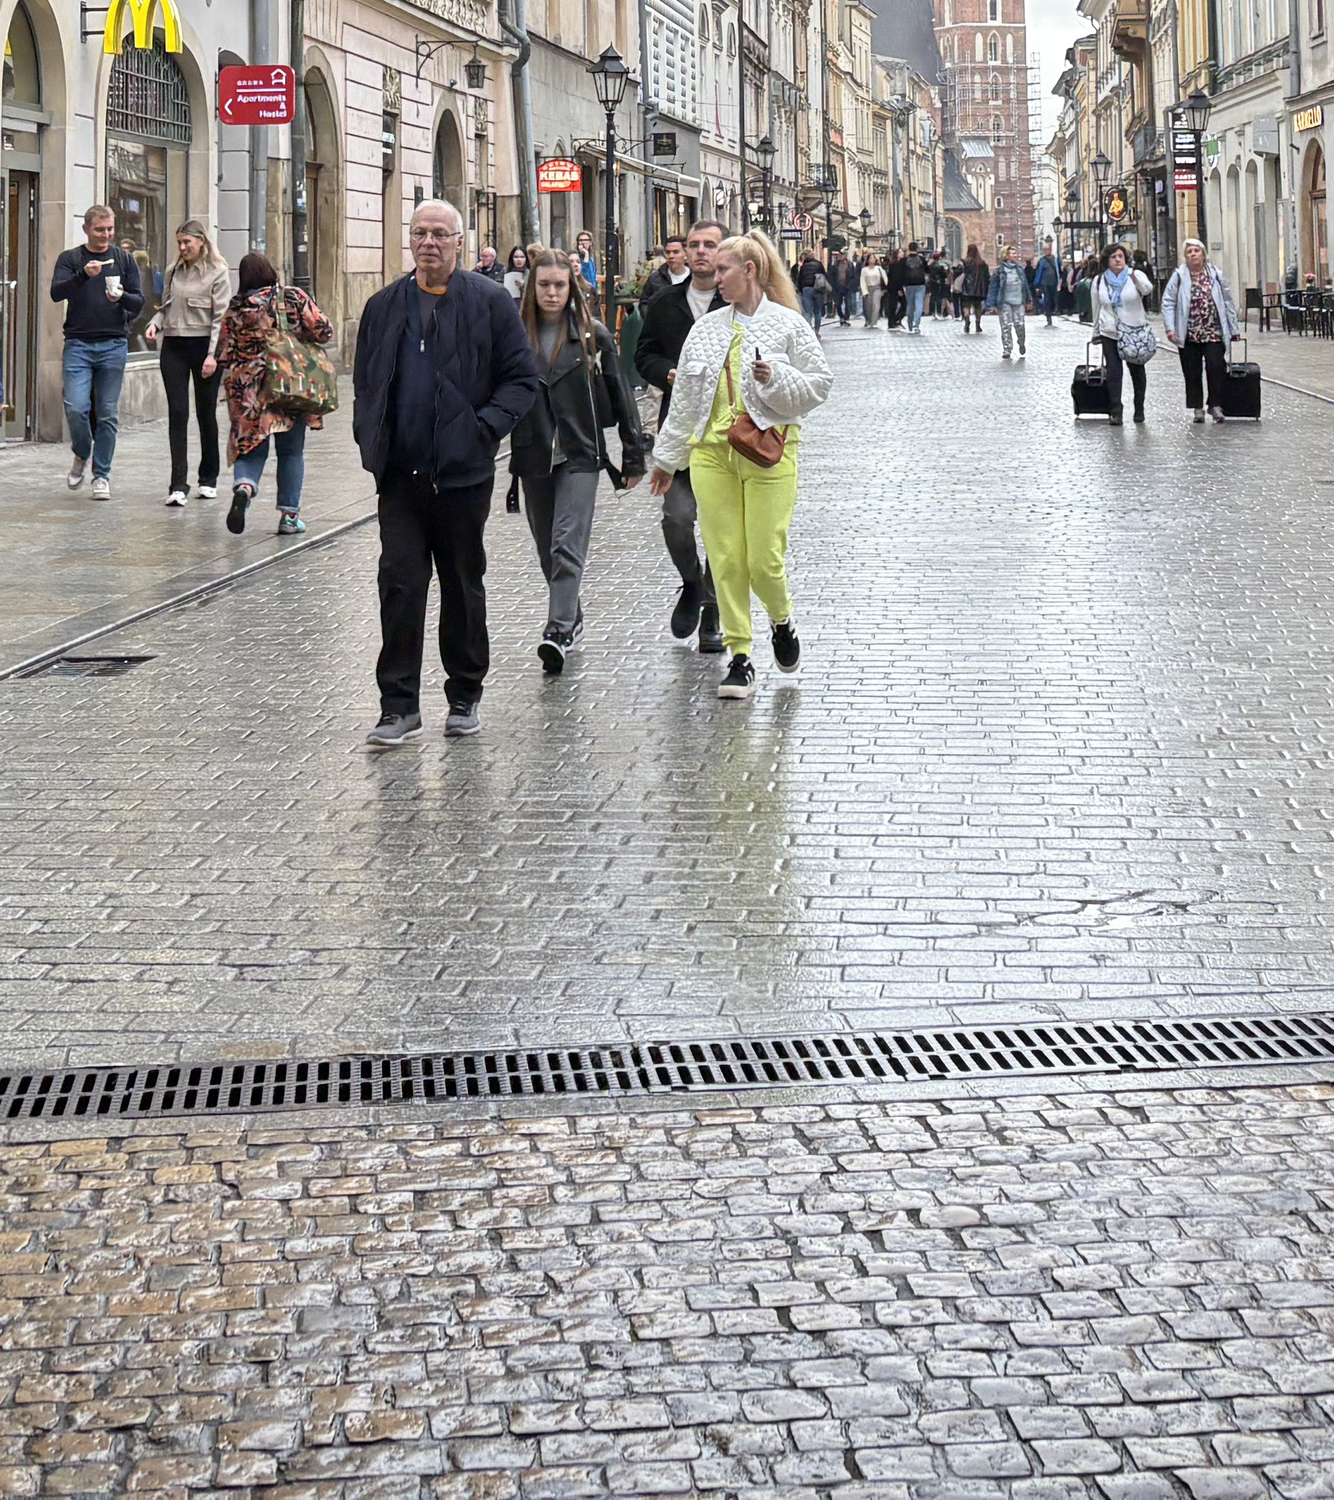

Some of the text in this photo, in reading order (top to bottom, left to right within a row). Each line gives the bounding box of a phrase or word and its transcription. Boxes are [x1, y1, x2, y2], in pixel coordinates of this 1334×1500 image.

[237, 94, 287, 104] Apartments
[259, 110, 287, 118] Hostel
[539, 171, 579, 181] KEBAB
